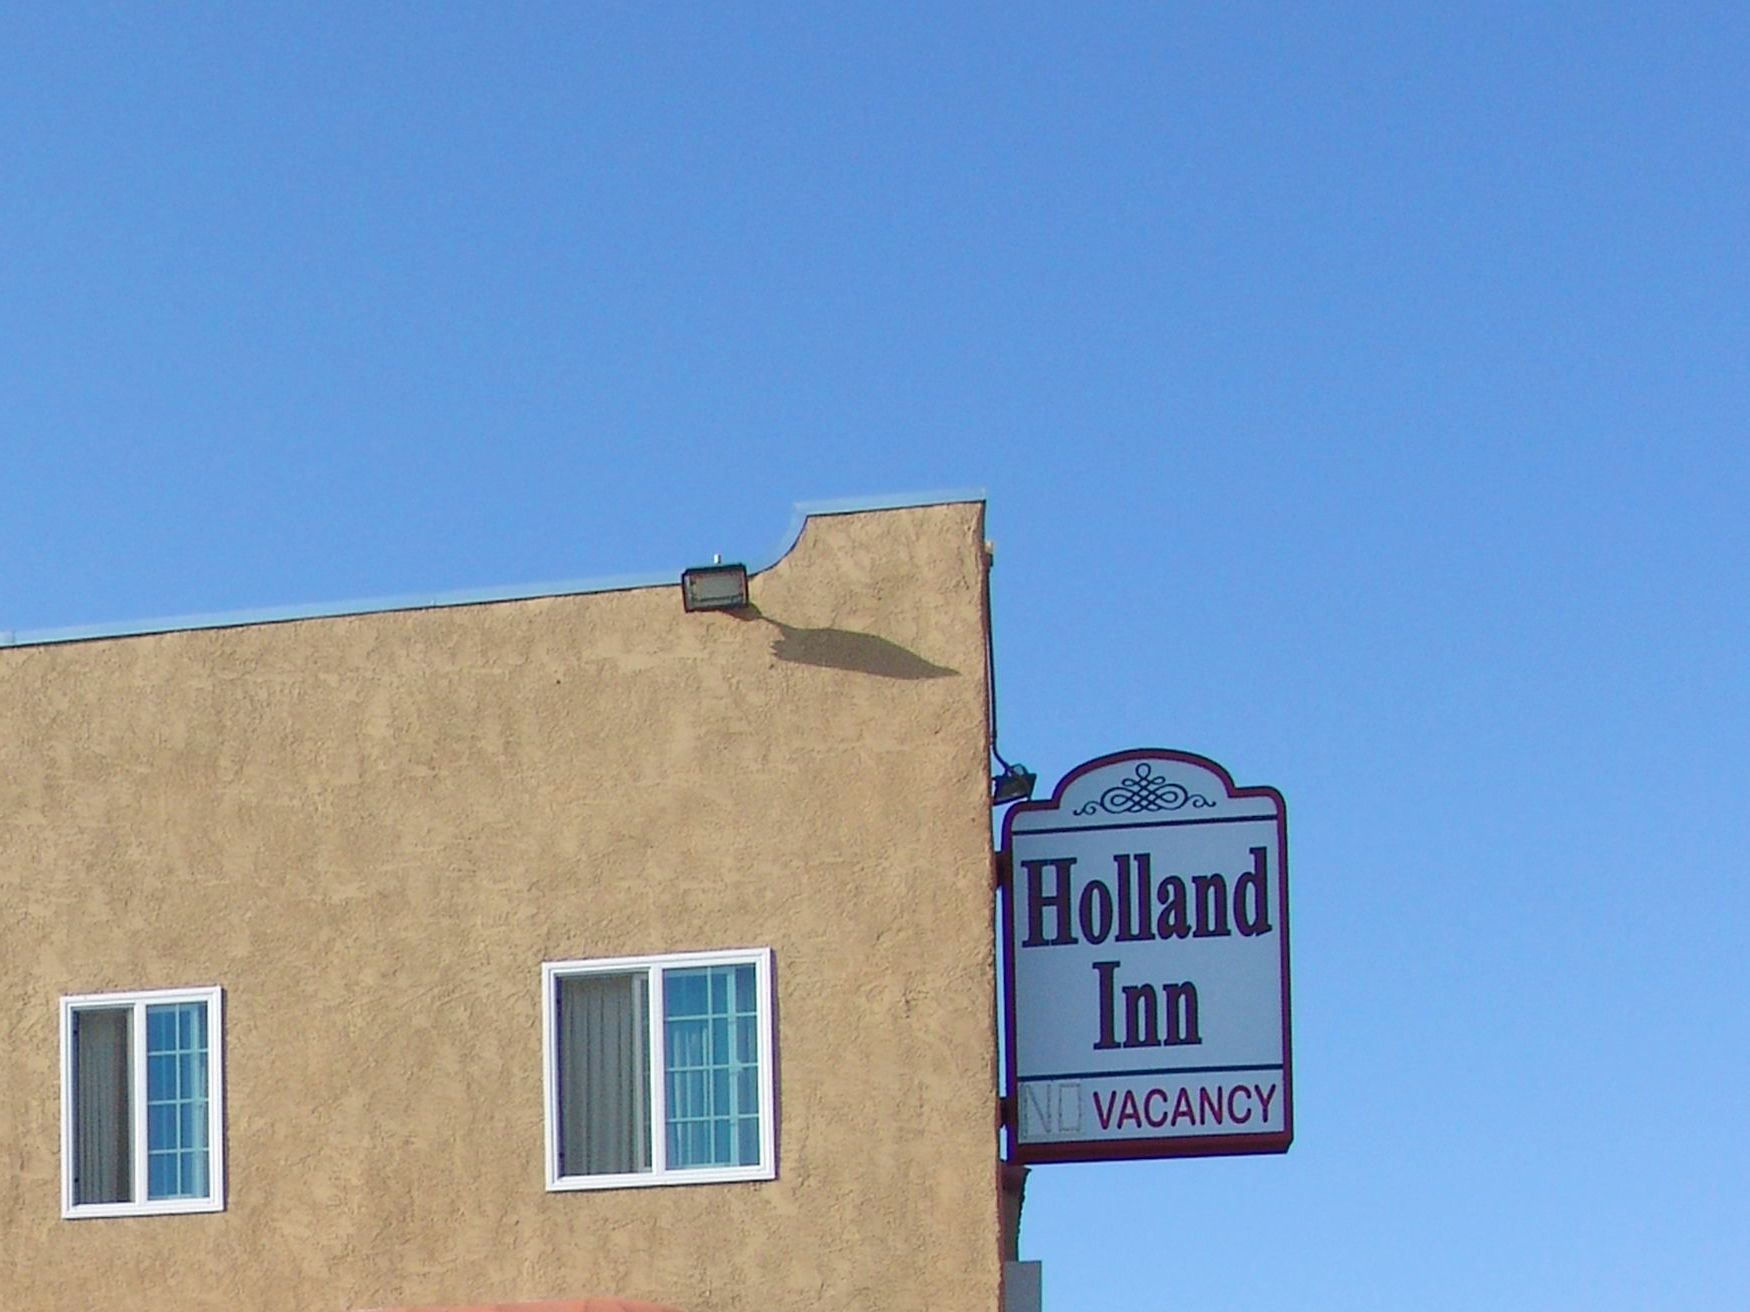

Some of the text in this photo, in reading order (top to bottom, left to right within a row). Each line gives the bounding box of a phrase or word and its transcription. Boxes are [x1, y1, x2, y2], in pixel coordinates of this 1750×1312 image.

[1021, 847, 1272, 947] Holland
[1092, 961, 1202, 1050] Inn
[1093, 1083, 1276, 1130] VACANCY
